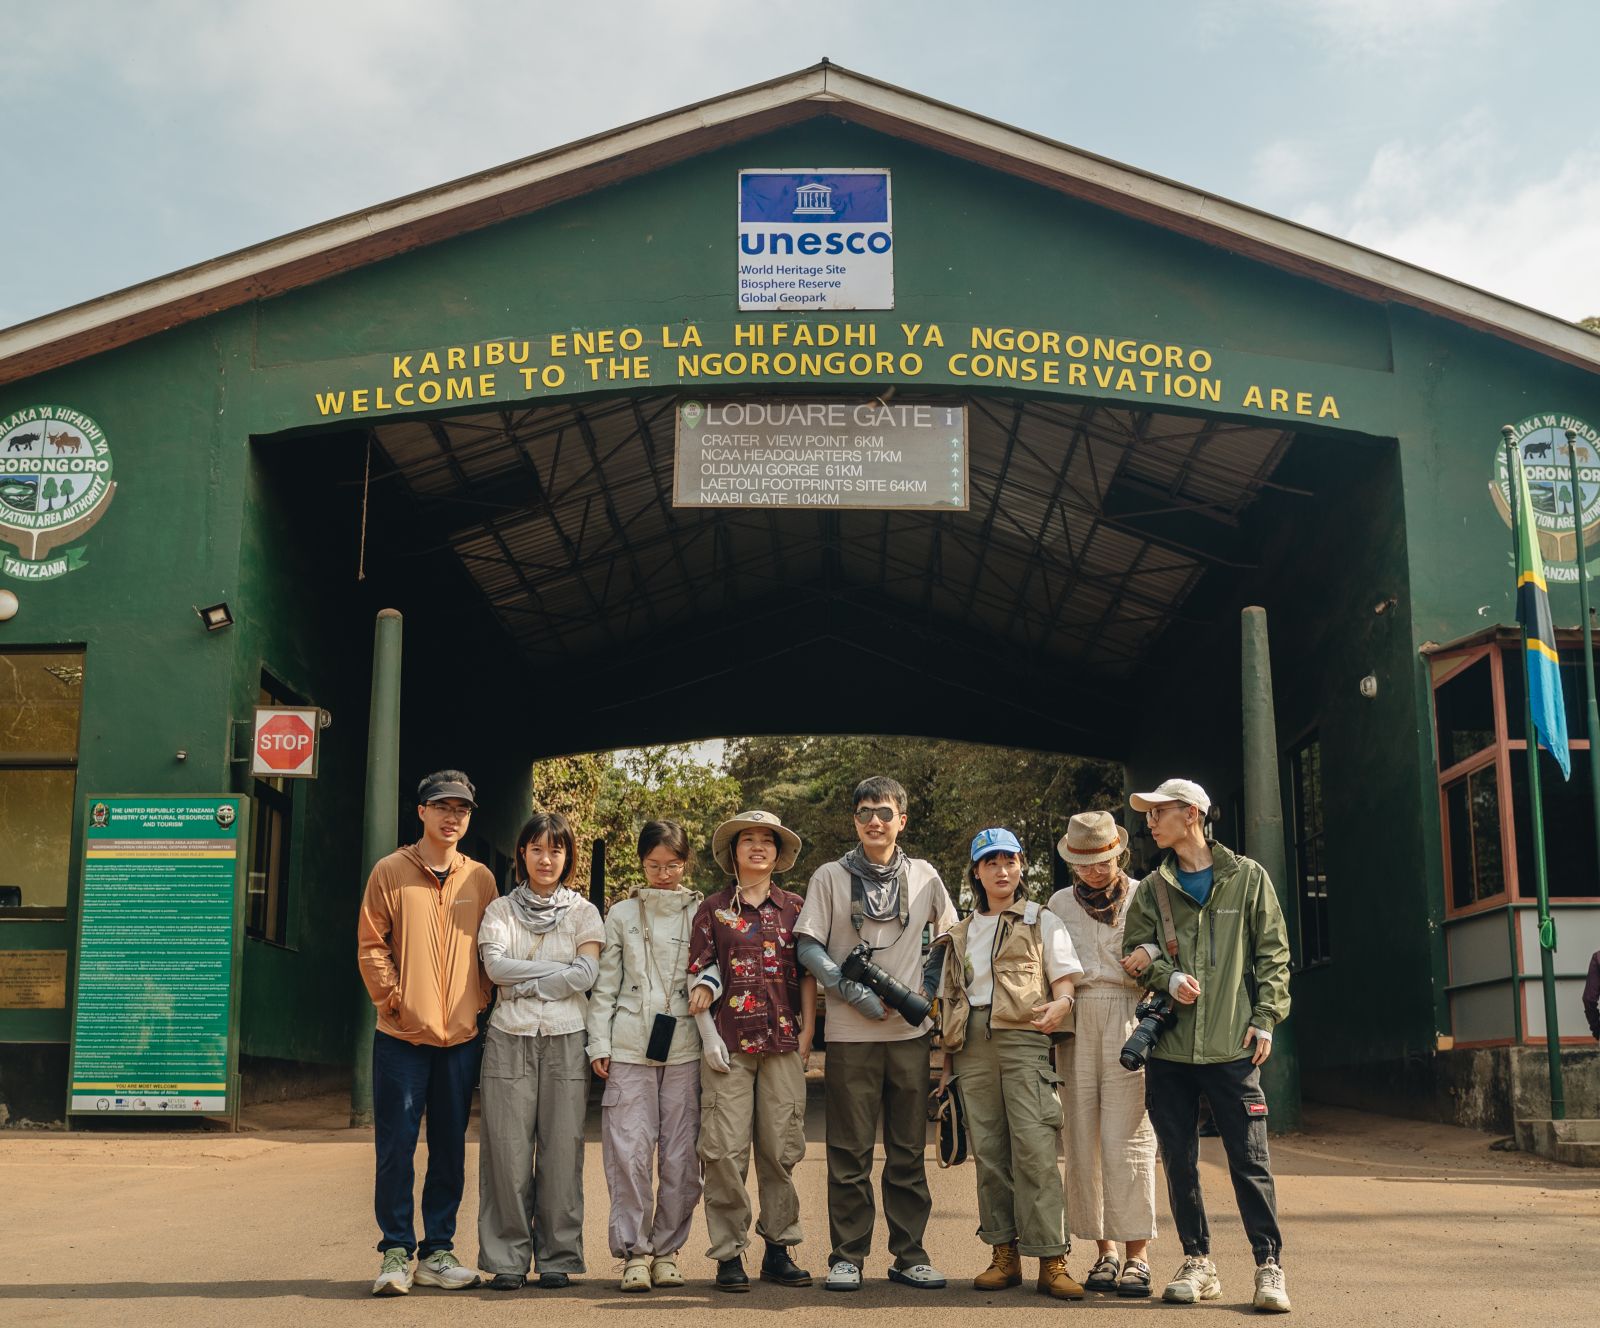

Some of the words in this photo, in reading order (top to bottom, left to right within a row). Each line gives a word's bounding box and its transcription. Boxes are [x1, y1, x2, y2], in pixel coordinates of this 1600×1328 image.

[741, 232, 892, 255] unesco
[741, 265, 773, 275] World
[776, 265, 823, 277] Heritage
[826, 265, 846, 274] Site
[741, 279, 796, 290] Biosphere
[799, 280, 841, 288] Reserve
[741, 293, 777, 303] Global
[779, 293, 826, 304] Geopark
[393, 342, 529, 379] KARIBU
[551, 329, 643, 357] ENEO
[663, 326, 703, 348] LA
[735, 324, 876, 346] HIFADHI
[901, 324, 944, 347] YA
[971, 328, 1212, 373] NGORONGORO
[315, 374, 496, 415] WELCOME
[519, 365, 566, 390] TO
[585, 356, 650, 380] THE
[678, 352, 923, 377] NGORONGORO
[948, 354, 1222, 401] CONSERVATION
[1243, 386, 1340, 419] AREA
[706, 403, 846, 426] LODUARE
[853, 403, 932, 427] GATE
[1542, 415, 1557, 426] YA
[39, 407, 53, 419] YA
[55, 407, 102, 440] HIFADHI
[95, 439, 108, 456] YA
[701, 434, 760, 446] CRATER
[766, 435, 802, 447] VIEW
[805, 435, 848, 447] POINT
[854, 435, 884, 447] 6KM
[701, 448, 741, 460] NCAA
[744, 449, 862, 462] HEADQUARTERS
[866, 450, 902, 462] 17KM
[701, 463, 763, 475] OLDUVAI
[766, 463, 819, 476] GORGE
[825, 464, 863, 477] 61KM
[701, 478, 758, 490] LAETOLI
[762, 478, 852, 491] FOOTPRINTS
[855, 479, 887, 492] SITE
[889, 480, 927, 492] 64KM
[0, 505, 36, 527] VATION
[36, 512, 62, 527] AREA
[63, 475, 106, 521] AUTHORITY
[700, 492, 742, 504] NAABI
[749, 492, 788, 505] GATE
[795, 493, 839, 505] 104KM
[1557, 516, 1576, 529] ARE
[5, 559, 67, 578] TANZANIA
[260, 734, 309, 751] STOP
